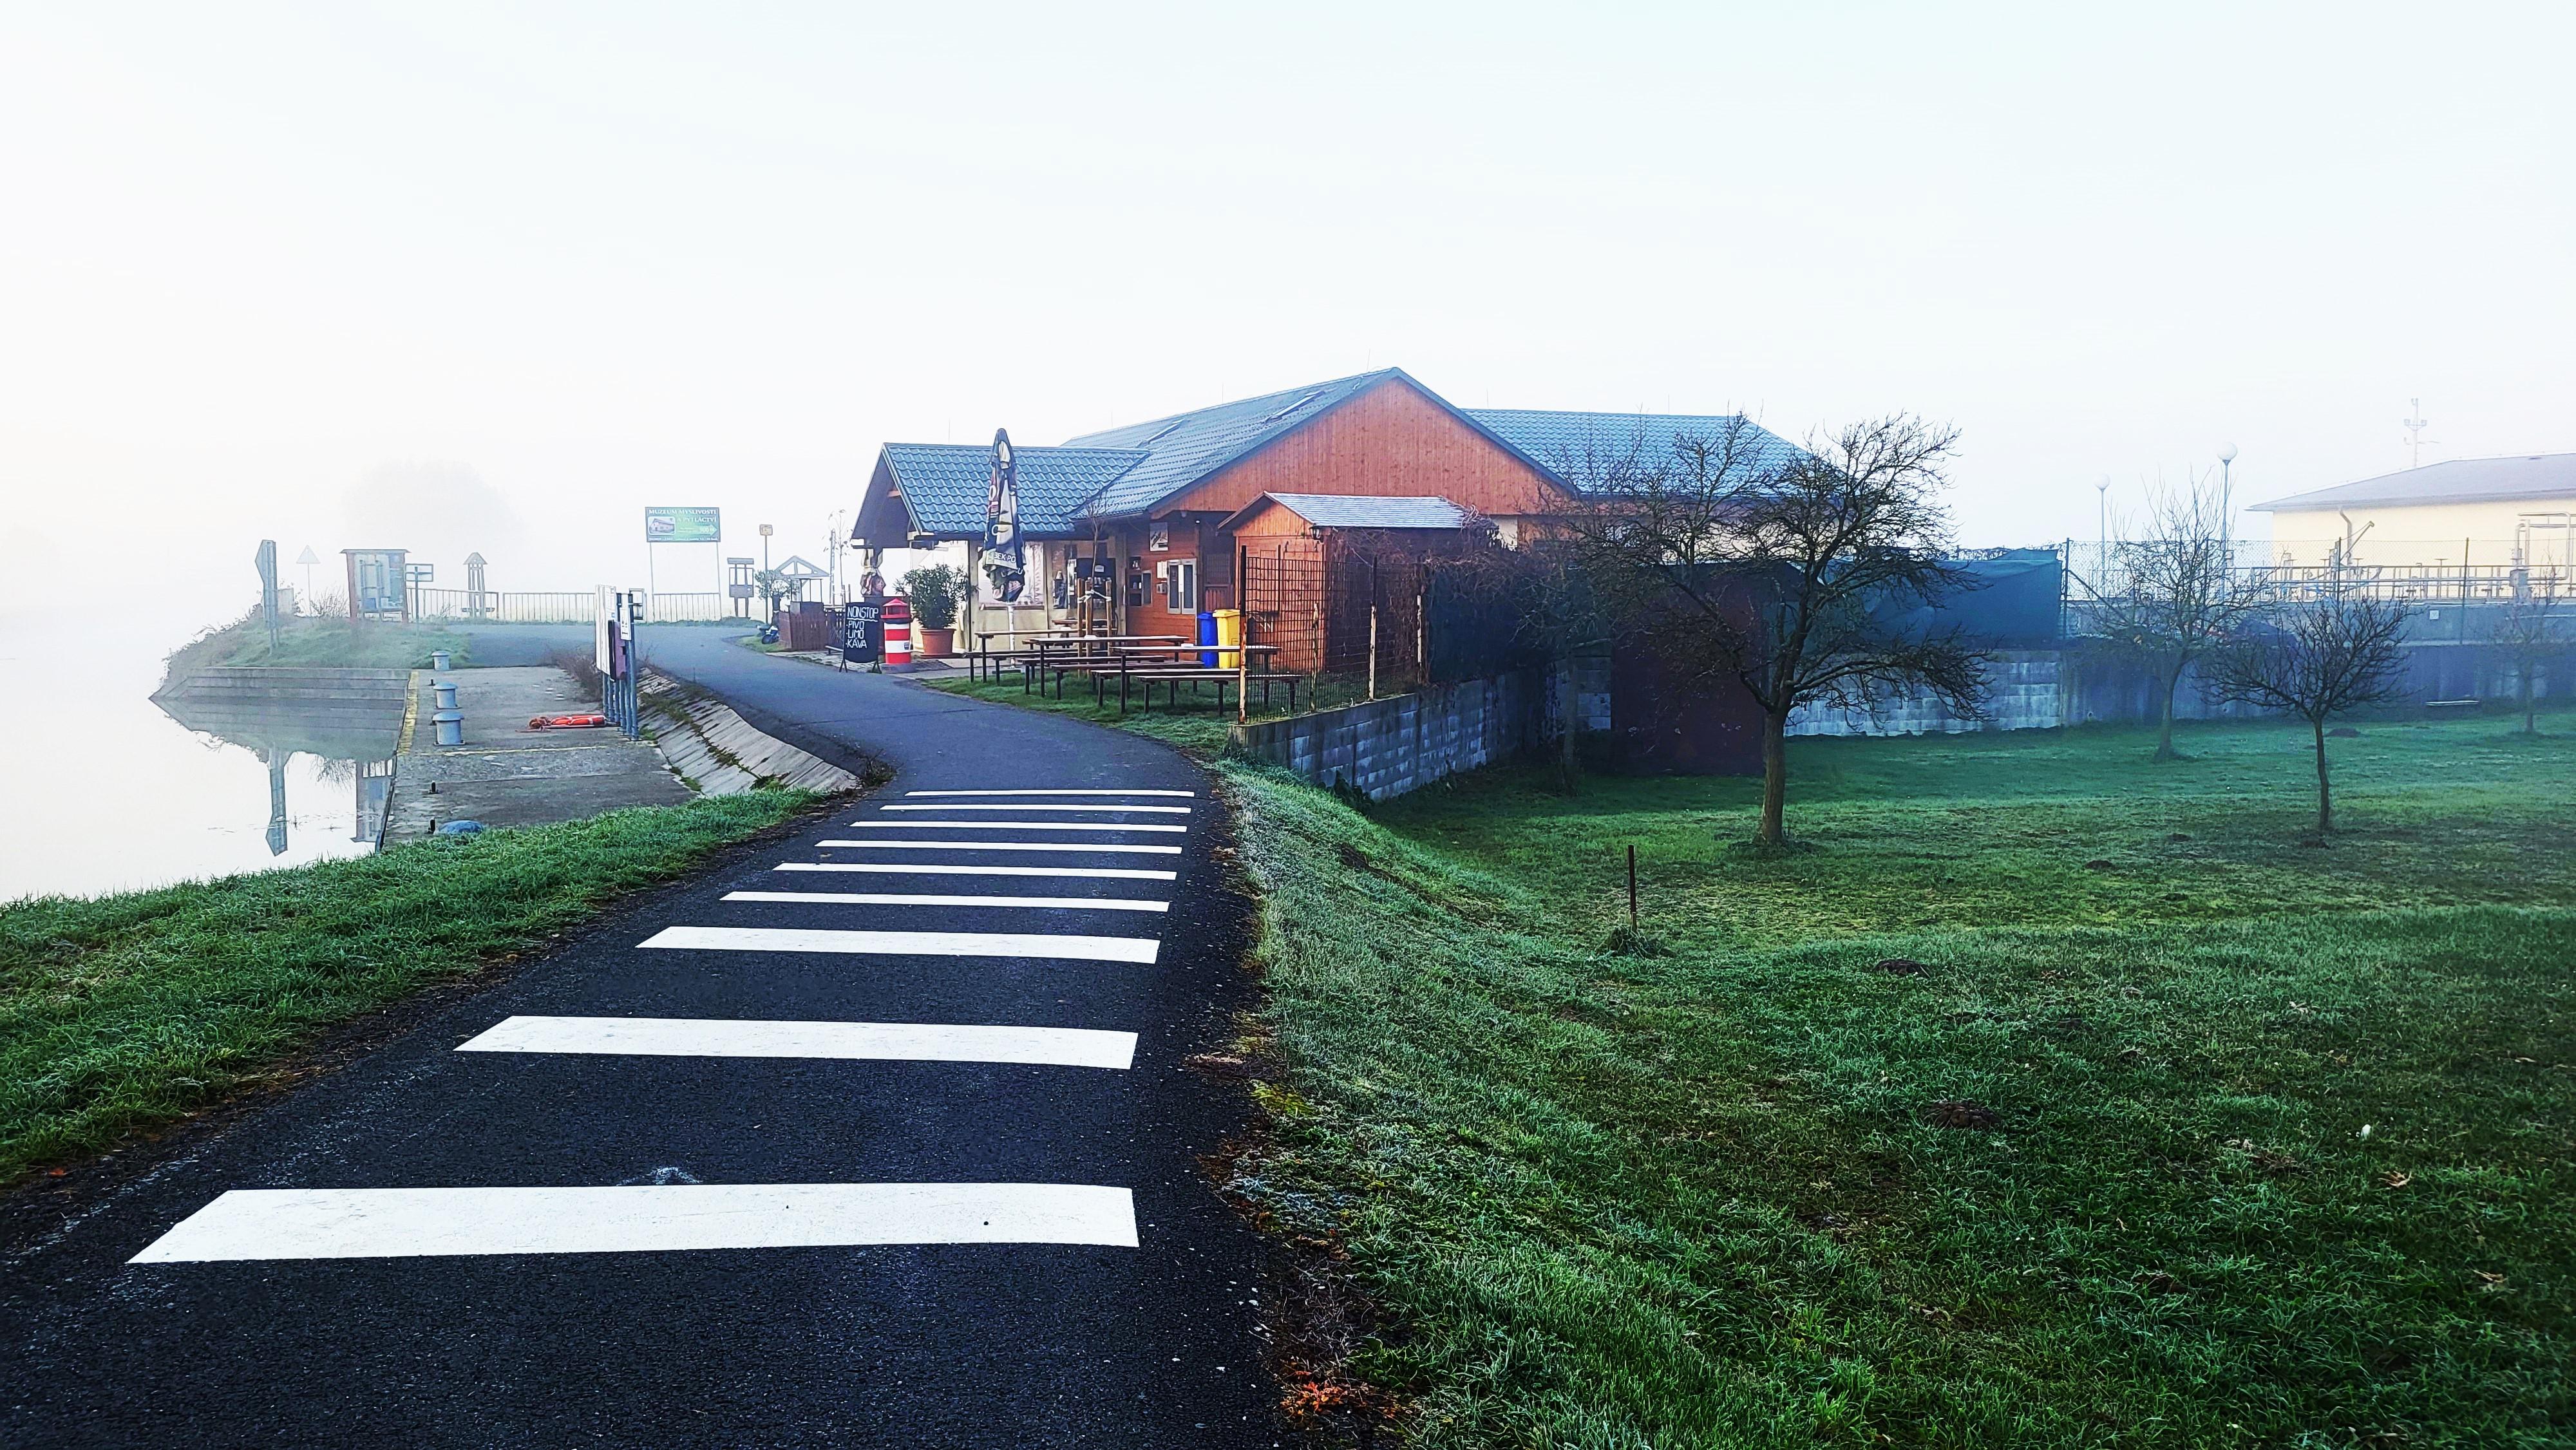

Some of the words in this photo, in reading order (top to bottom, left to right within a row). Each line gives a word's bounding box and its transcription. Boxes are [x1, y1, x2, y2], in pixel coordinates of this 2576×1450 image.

[848, 607, 878, 618] NONSTOP
[848, 621, 865, 630] PIVO
[848, 629, 864, 639] LIMO
[847, 637, 867, 648] KÁVA
